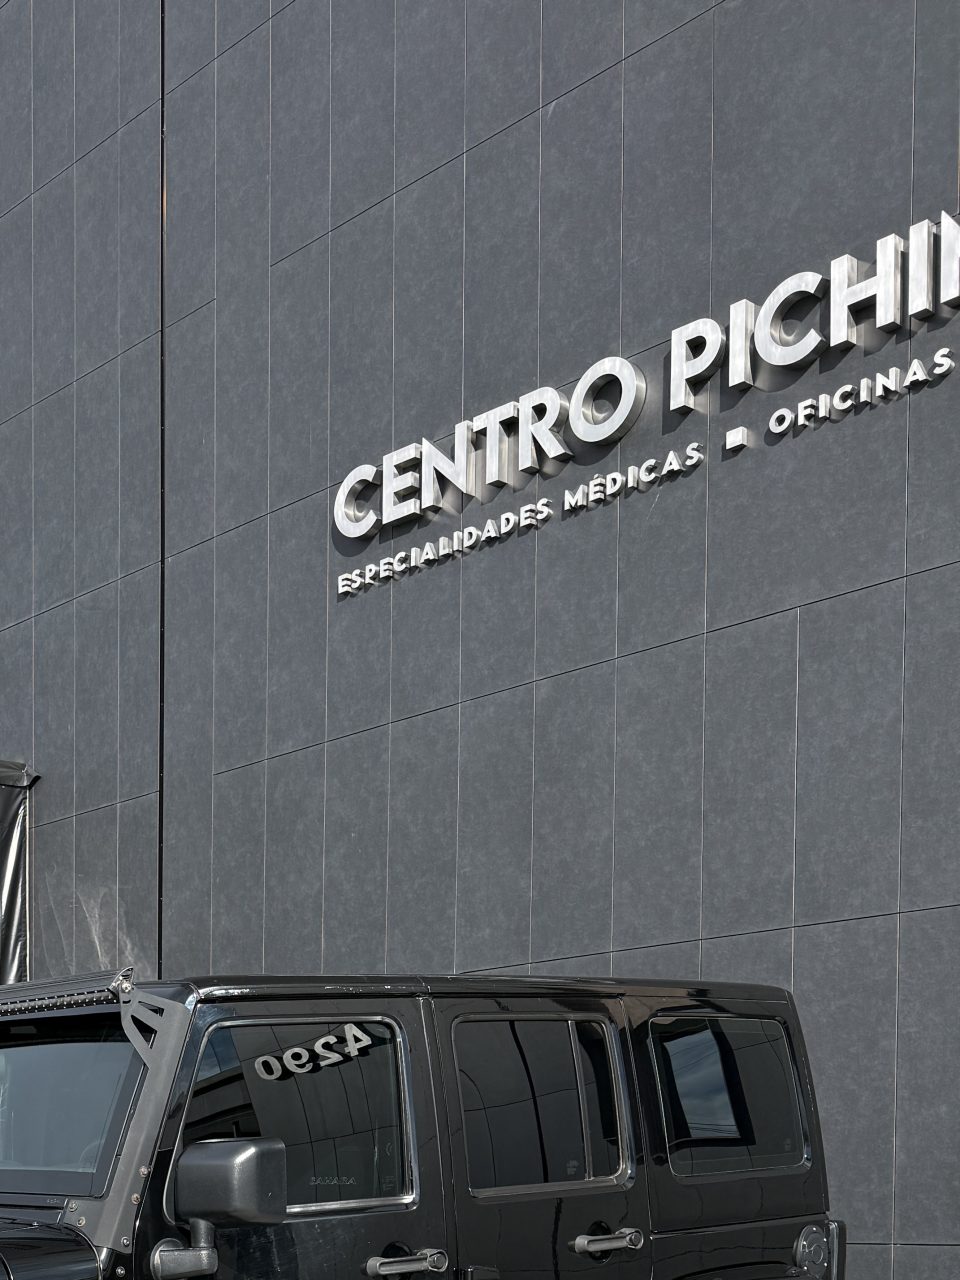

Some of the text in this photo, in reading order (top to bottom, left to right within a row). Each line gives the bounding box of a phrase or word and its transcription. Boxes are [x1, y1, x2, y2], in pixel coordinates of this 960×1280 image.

[334, 356, 645, 538] CENTRO
[338, 347, 955, 594] ESPECIALIDADES MÉDICAS OFICINAS
